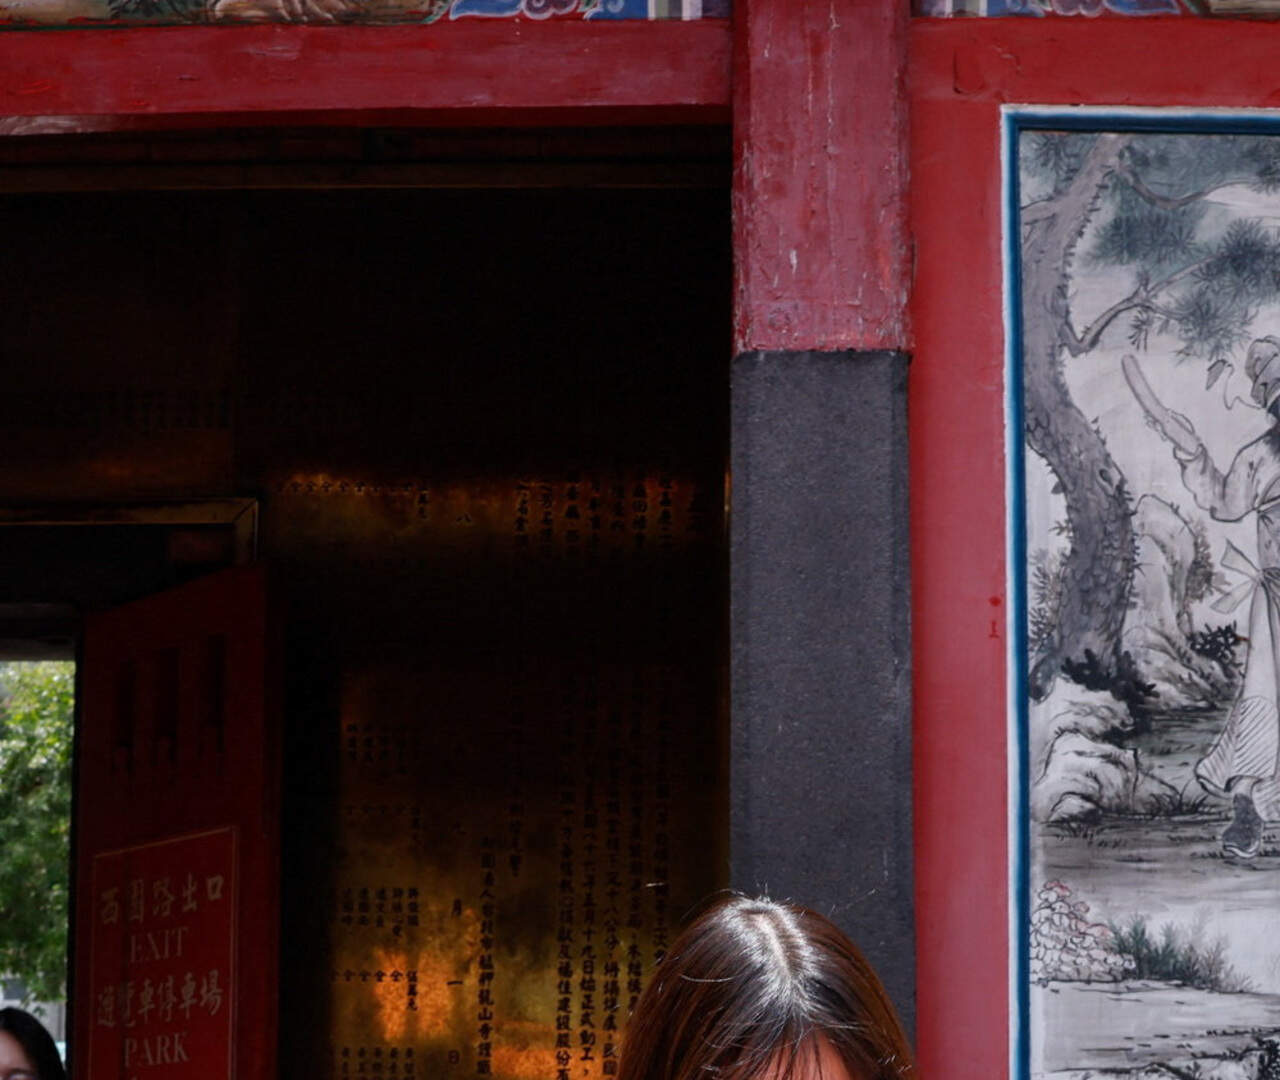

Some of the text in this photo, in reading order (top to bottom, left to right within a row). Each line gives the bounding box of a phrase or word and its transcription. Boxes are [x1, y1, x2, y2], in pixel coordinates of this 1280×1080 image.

[99, 872, 225, 927] 西園路出口
[130, 927, 191, 964] EXIT
[123, 1031, 191, 1069] PARK
